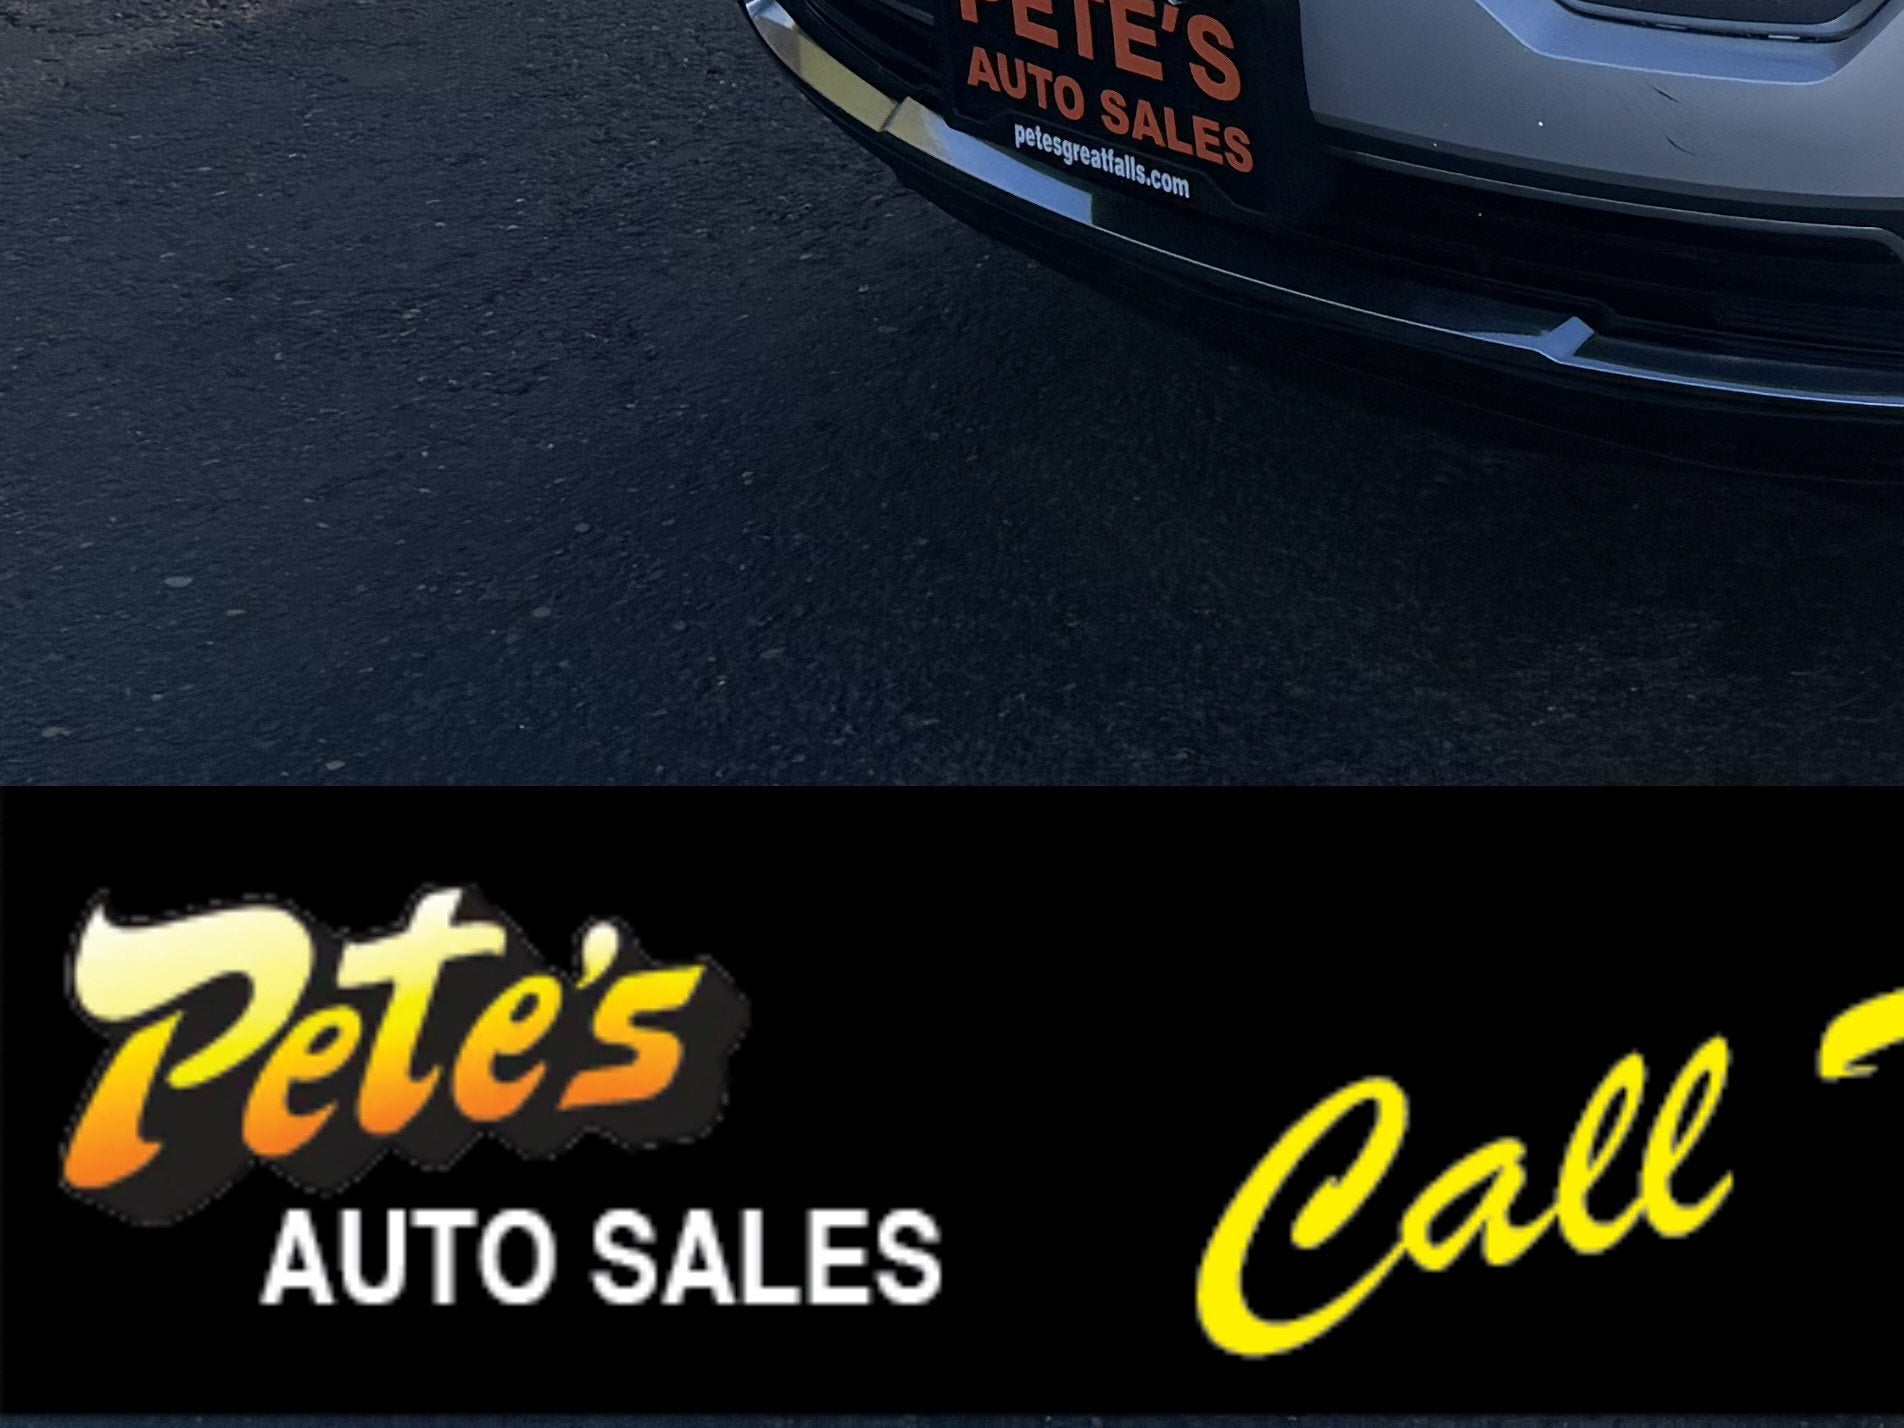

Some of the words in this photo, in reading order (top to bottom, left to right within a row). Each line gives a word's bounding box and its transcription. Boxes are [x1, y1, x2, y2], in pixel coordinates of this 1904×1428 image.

[967, 45, 1085, 122] AUTO
[1099, 88, 1254, 173] SALES
[1014, 123, 1190, 199] petesgreatfalls.com
